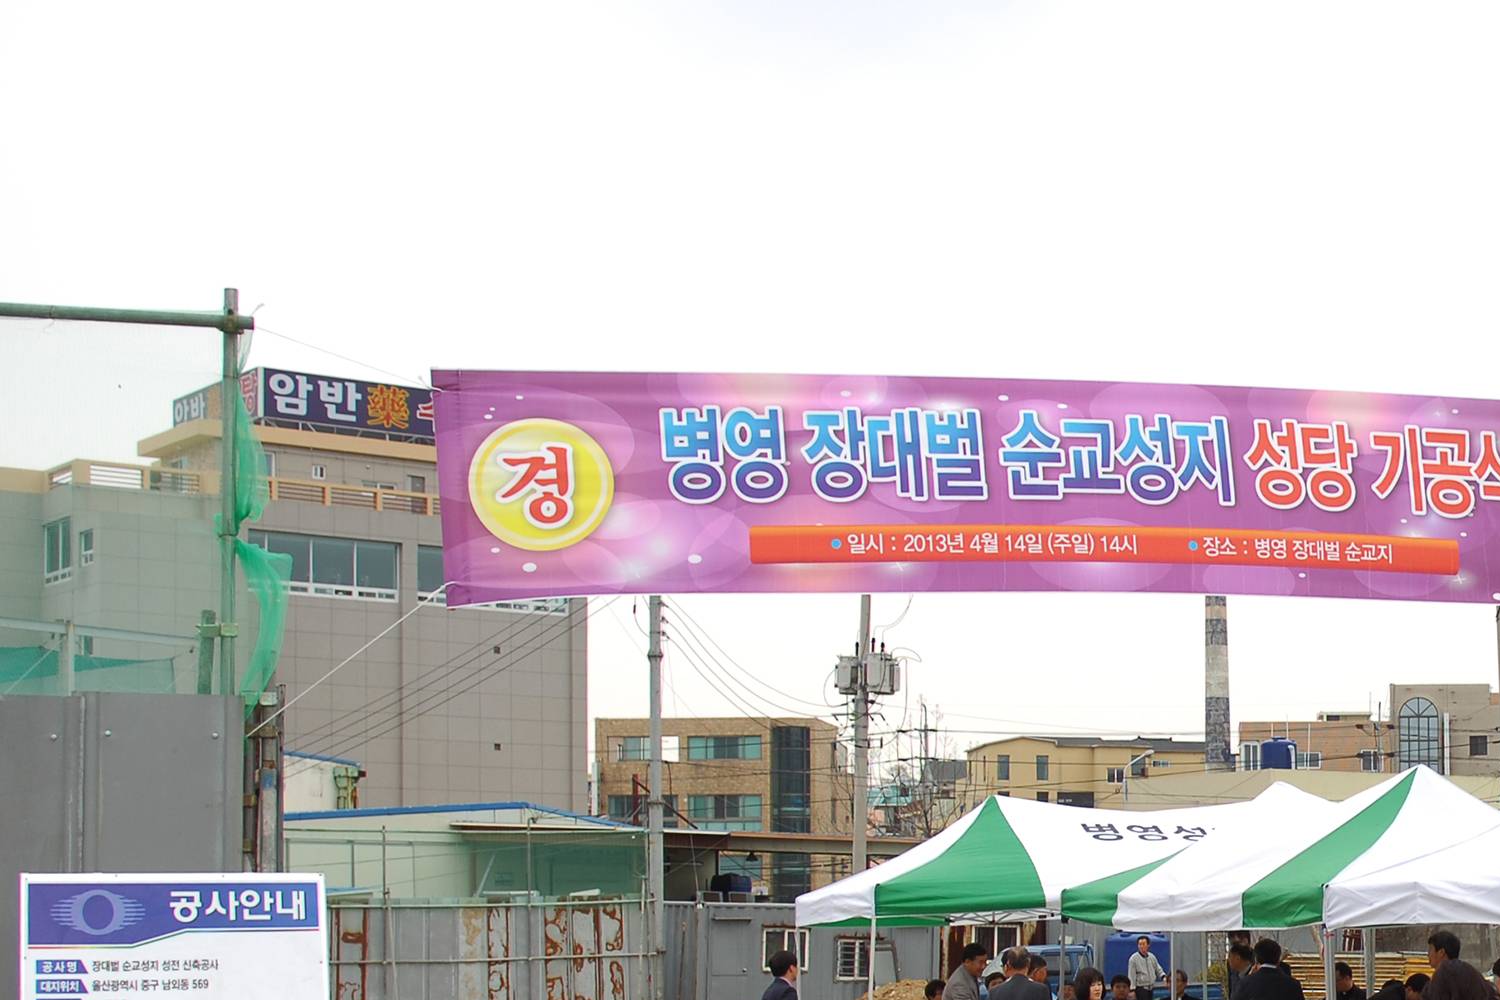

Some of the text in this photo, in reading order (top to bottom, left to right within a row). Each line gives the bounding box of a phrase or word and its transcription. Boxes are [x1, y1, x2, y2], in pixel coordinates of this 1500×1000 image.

[659, 405, 788, 503] 병영
[801, 406, 988, 502] 장대벌
[999, 409, 1236, 507] 순교성지
[1244, 418, 1358, 512] 성당
[497, 441, 574, 530] 경
[847, 534, 884, 554] 일시
[904, 533, 964, 554] 2013년
[970, 534, 999, 554] 4월
[1005, 533, 1043, 554] 14일
[1048, 531, 1095, 556] (주일)
[1101, 534, 1137, 555] 14시
[1203, 536, 1237, 556] 장소
[1255, 538, 1287, 558] 병영
[1292, 539, 1340, 560] 장대벌
[1345, 540, 1392, 563] 순교지
[1081, 823, 1216, 842] 병영성
[169, 889, 306, 923] 공사안내
[42, 961, 77, 973] 공사명
[92, 959, 219, 972] 장대벌 순교성지 성전 신축공사
[40, 980, 79, 992] 대지위치
[92, 979, 209, 992] 울산광역시 중구 남외동 569
